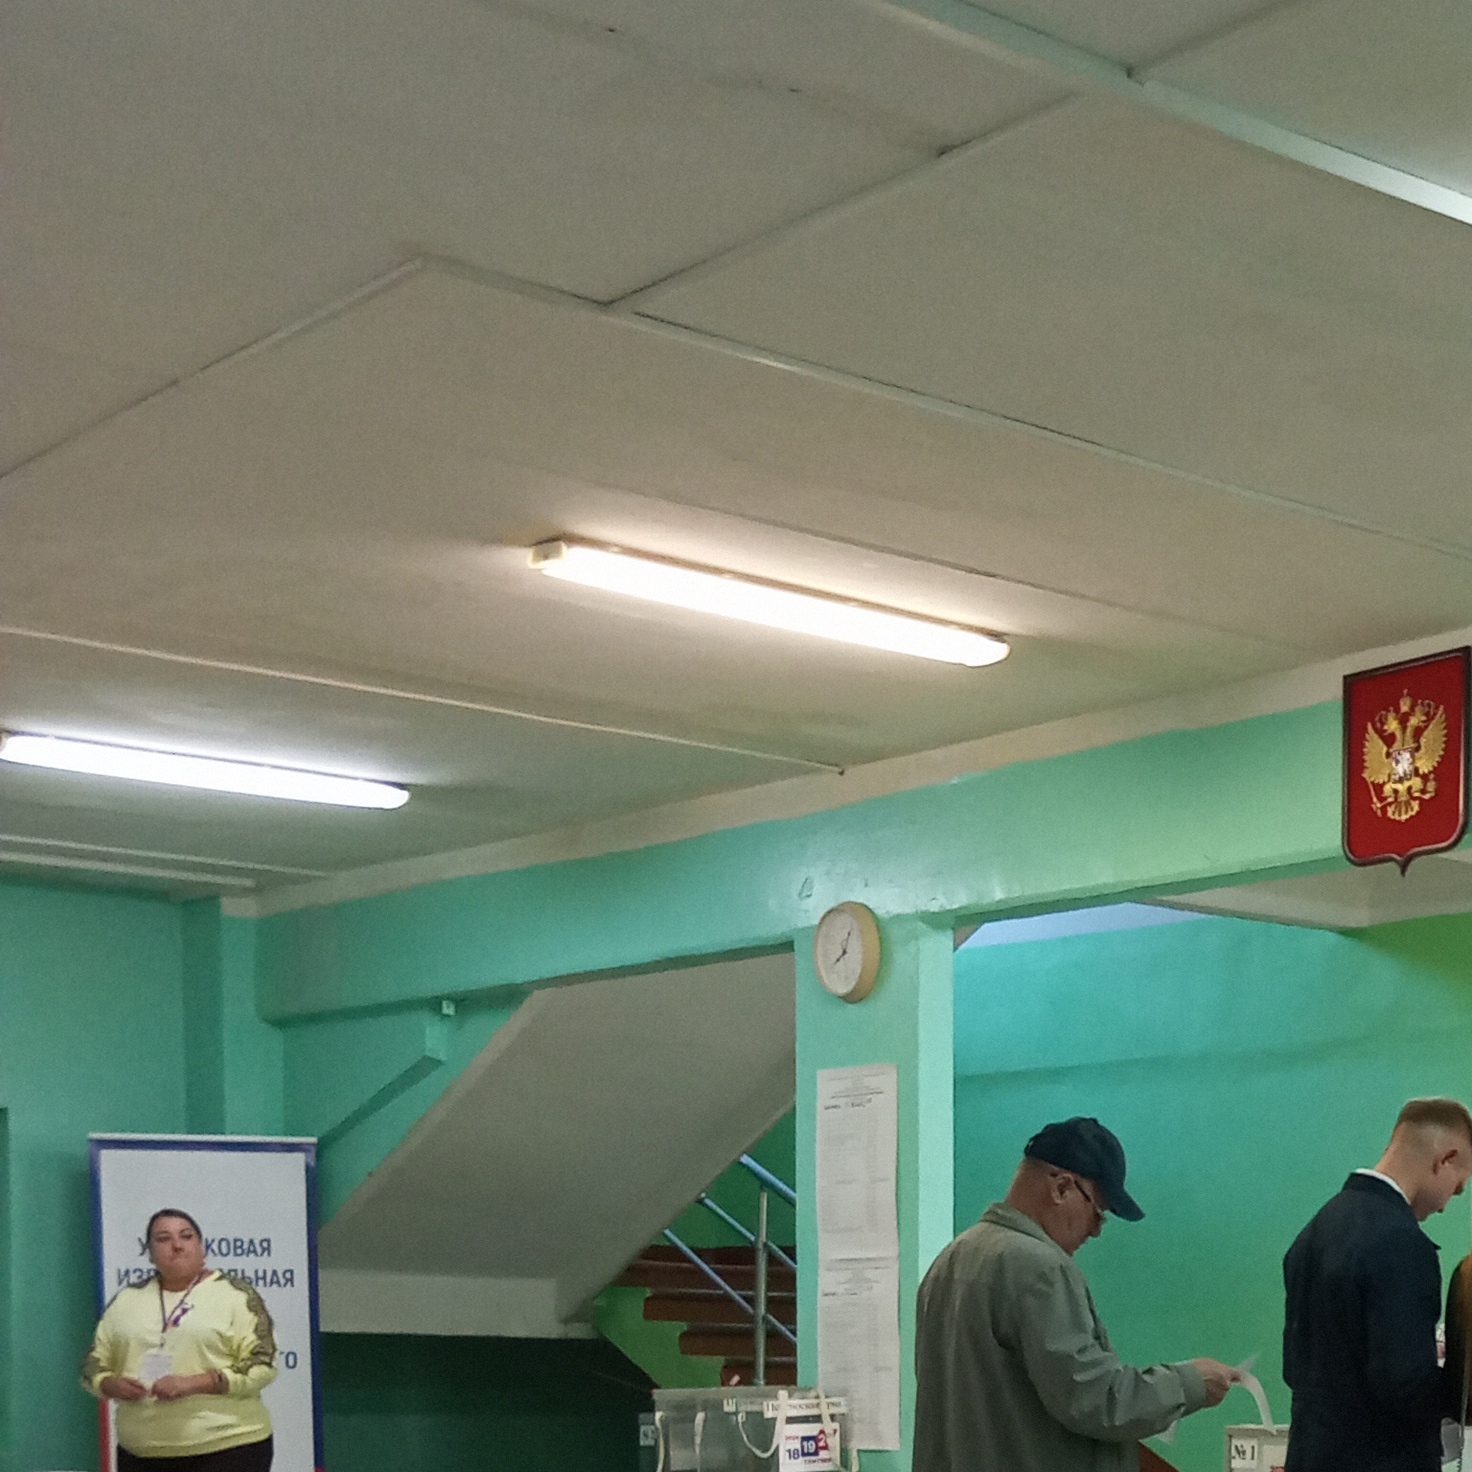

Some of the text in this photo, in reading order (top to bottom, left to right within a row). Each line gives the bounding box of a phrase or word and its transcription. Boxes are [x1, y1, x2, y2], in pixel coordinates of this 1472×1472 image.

[138, 1237, 271, 1257] УКОВАЯ
[786, 1448, 800, 1460] 18
[802, 1440, 816, 1454] 19
